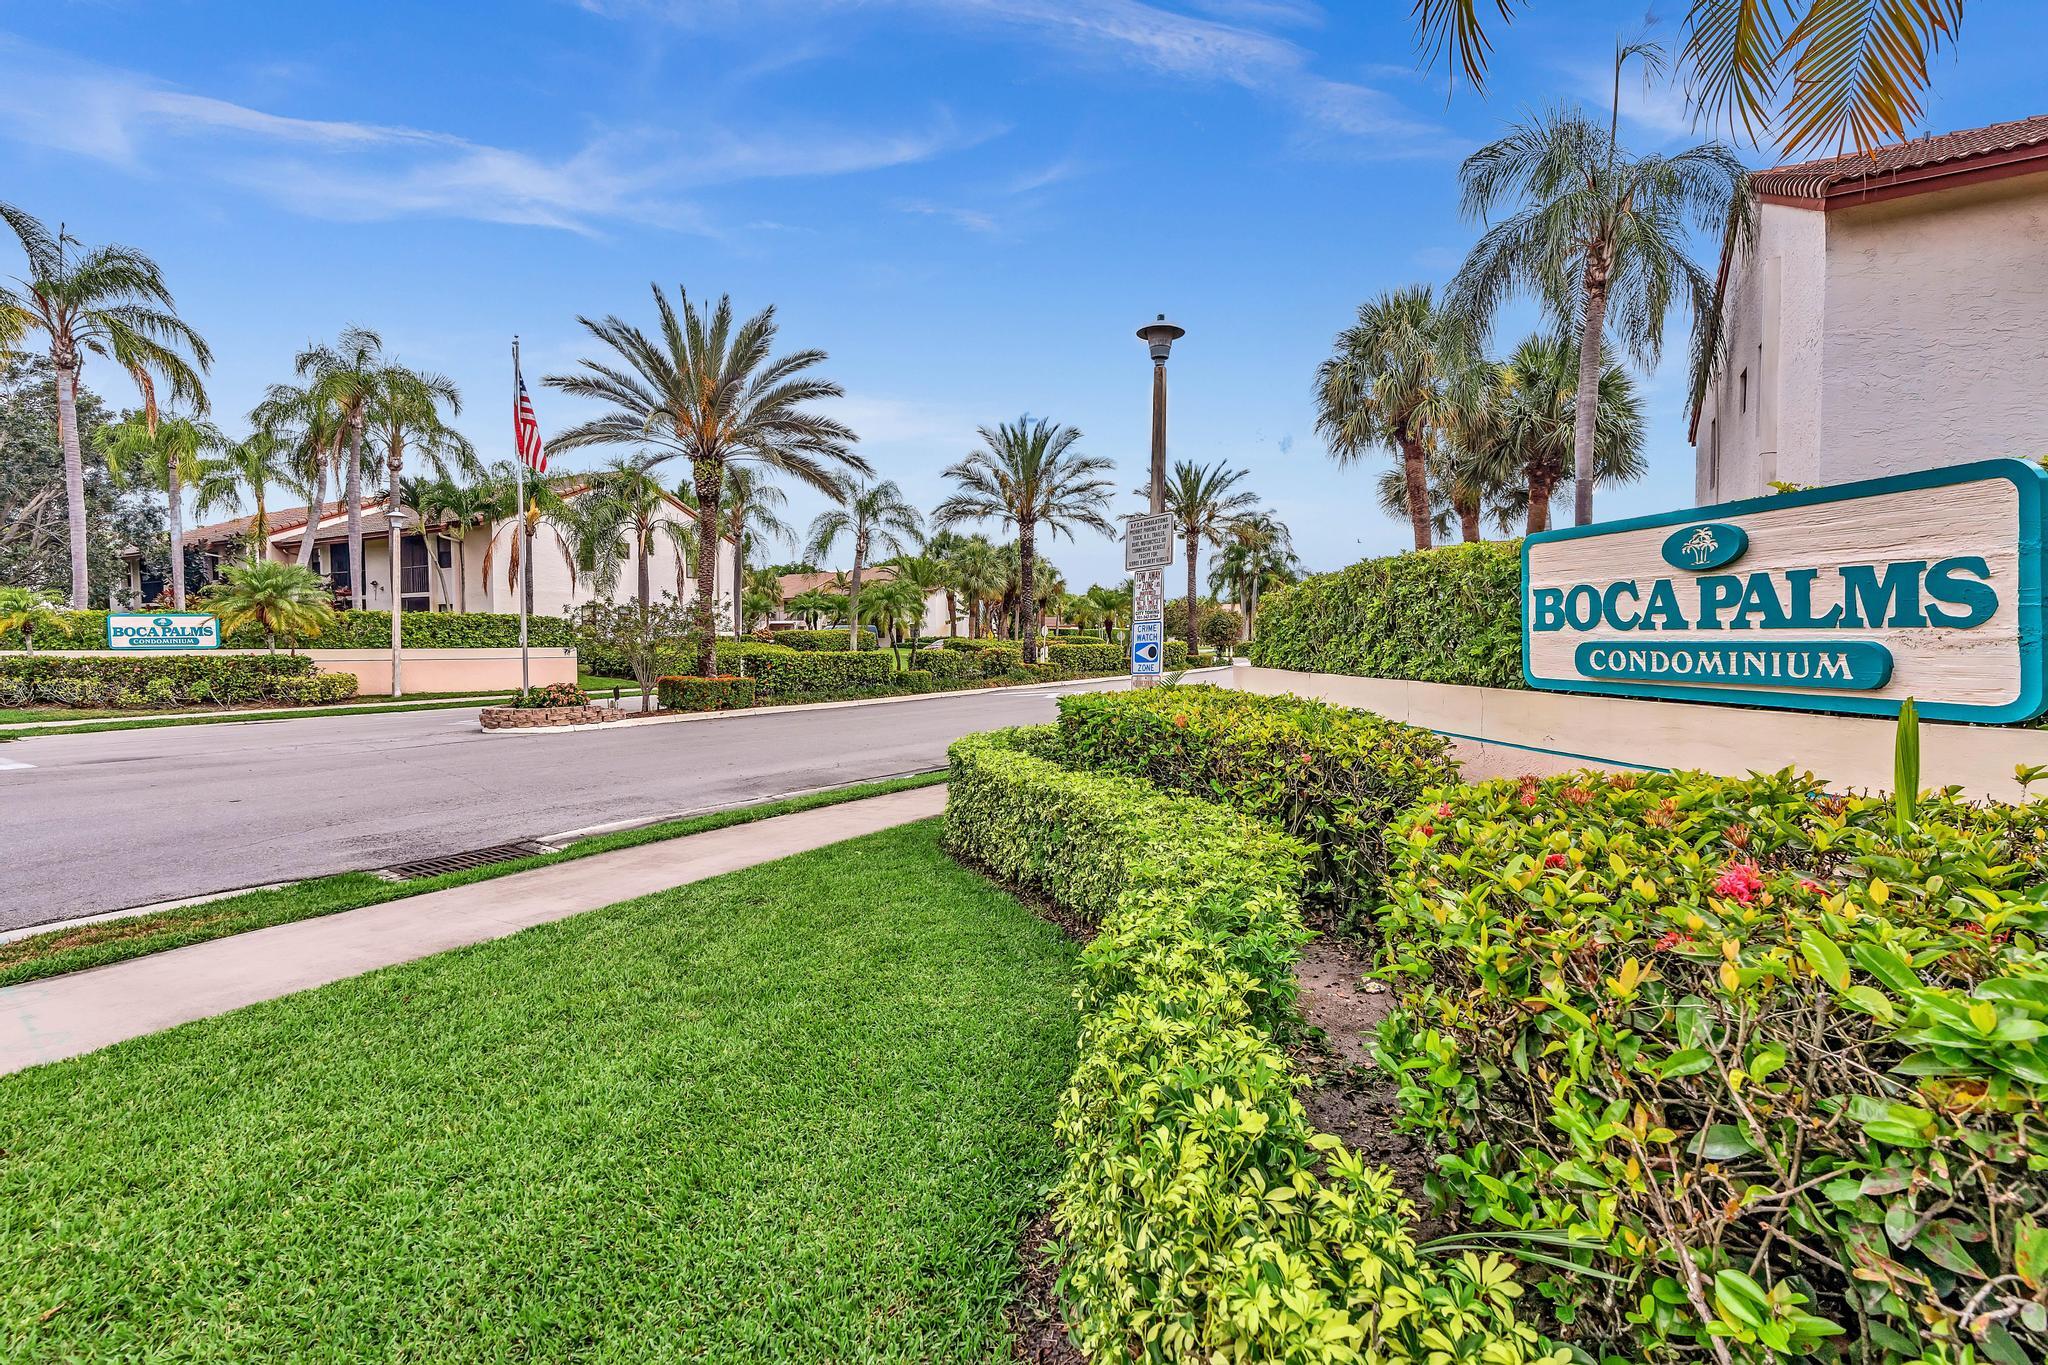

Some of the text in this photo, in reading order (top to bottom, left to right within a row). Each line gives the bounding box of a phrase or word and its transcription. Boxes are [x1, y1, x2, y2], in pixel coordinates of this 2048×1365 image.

[1144, 517, 1168, 527] REGULATIONS
[1136, 571, 1160, 582] TOW AWAY
[1142, 581, 1154, 591] ZONE
[1533, 555, 2000, 632] BOCA PALMS
[112, 626, 214, 637] BOCA PALMS
[1136, 634, 1158, 642] WATCH
[1589, 648, 1853, 681] CONDOMINIUM
